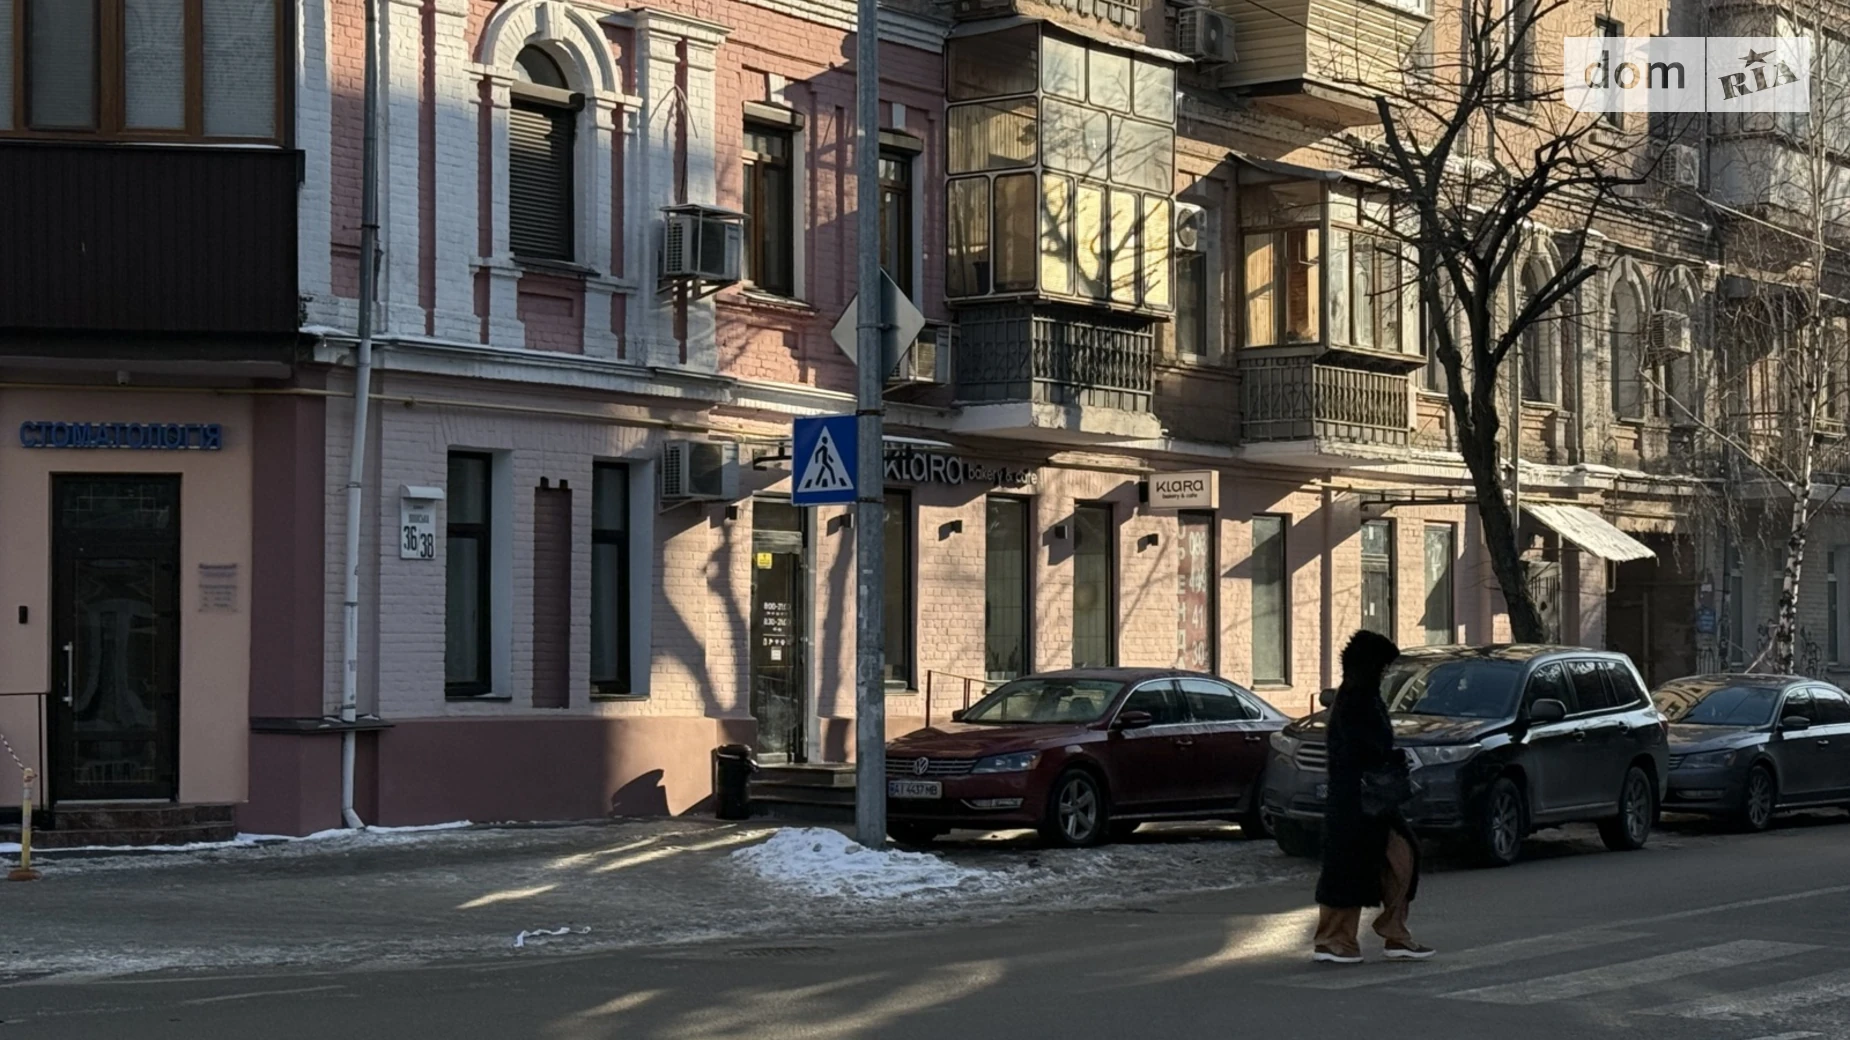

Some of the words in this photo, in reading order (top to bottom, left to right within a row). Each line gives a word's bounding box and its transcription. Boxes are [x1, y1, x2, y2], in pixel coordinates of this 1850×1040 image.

[19, 421, 223, 449] СТОМАТОЛОГІЯ
[968, 464, 1003, 483] bakery
[1015, 470, 1038, 484] cafe
